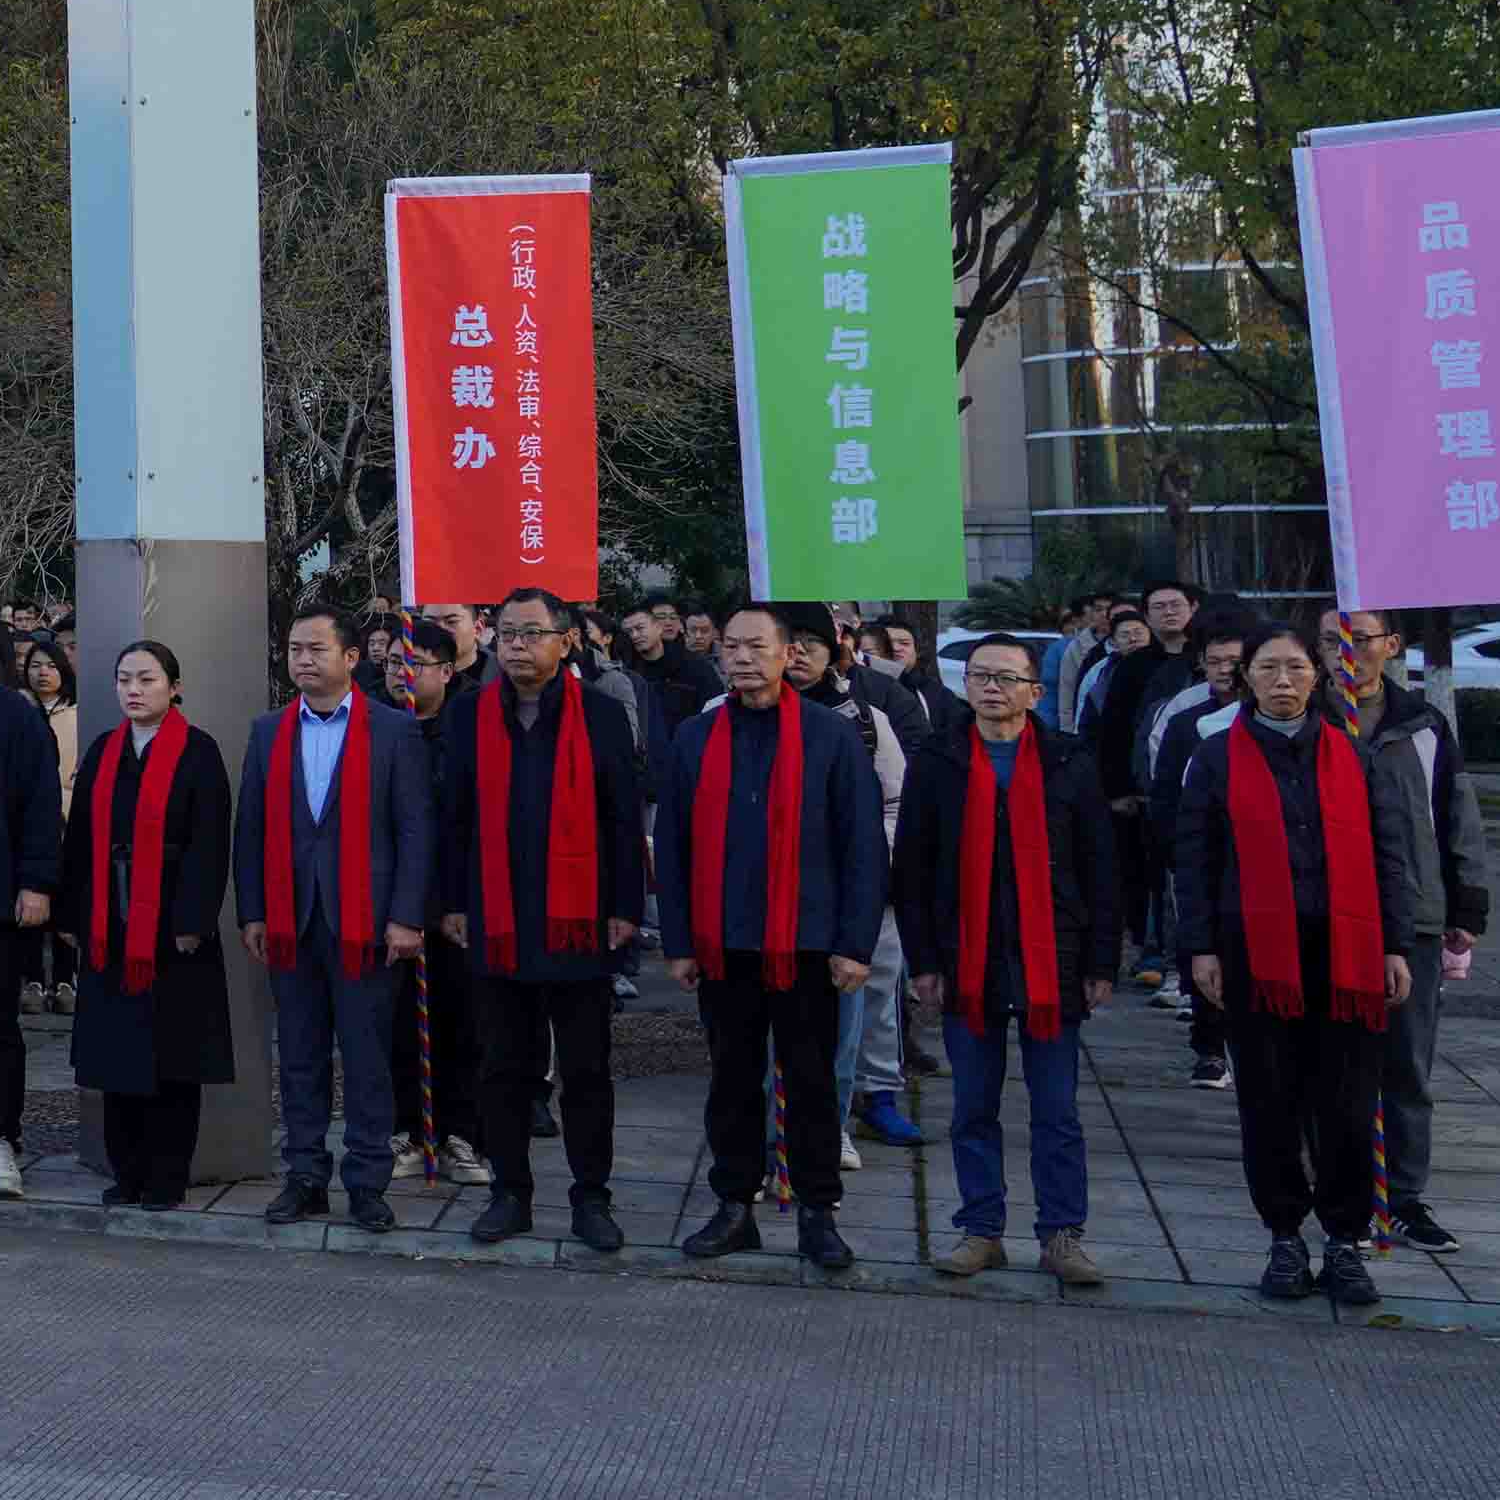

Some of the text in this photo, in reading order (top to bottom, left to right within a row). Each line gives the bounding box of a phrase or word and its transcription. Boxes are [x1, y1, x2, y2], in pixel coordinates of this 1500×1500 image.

[450, 304, 496, 469] 总裁办
[821, 213, 879, 544] 战略与信息部
[1417, 201, 1498, 531] 品质管理部
